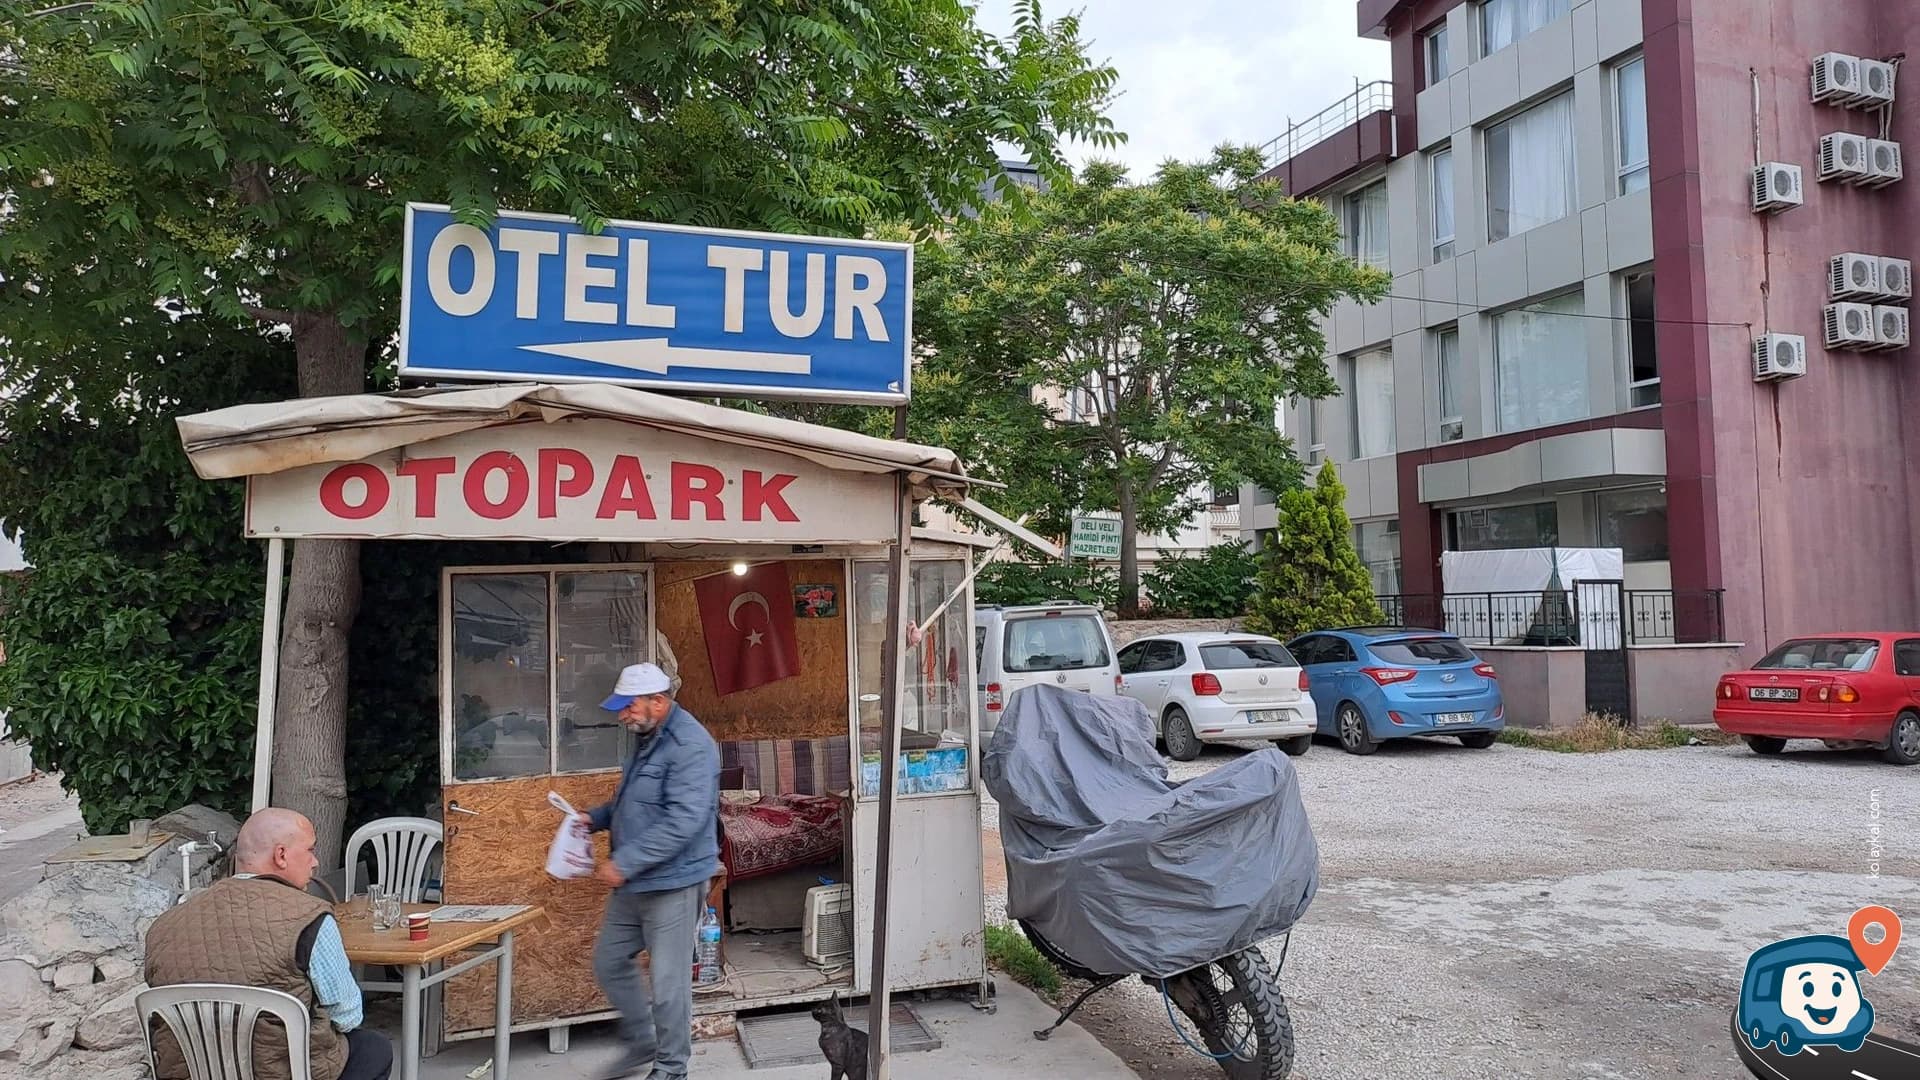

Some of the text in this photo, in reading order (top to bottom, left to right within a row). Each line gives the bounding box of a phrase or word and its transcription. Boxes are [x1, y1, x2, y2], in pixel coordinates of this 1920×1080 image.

[427, 223, 890, 343] OTEL TUR
[319, 448, 801, 522] OTOPARK
